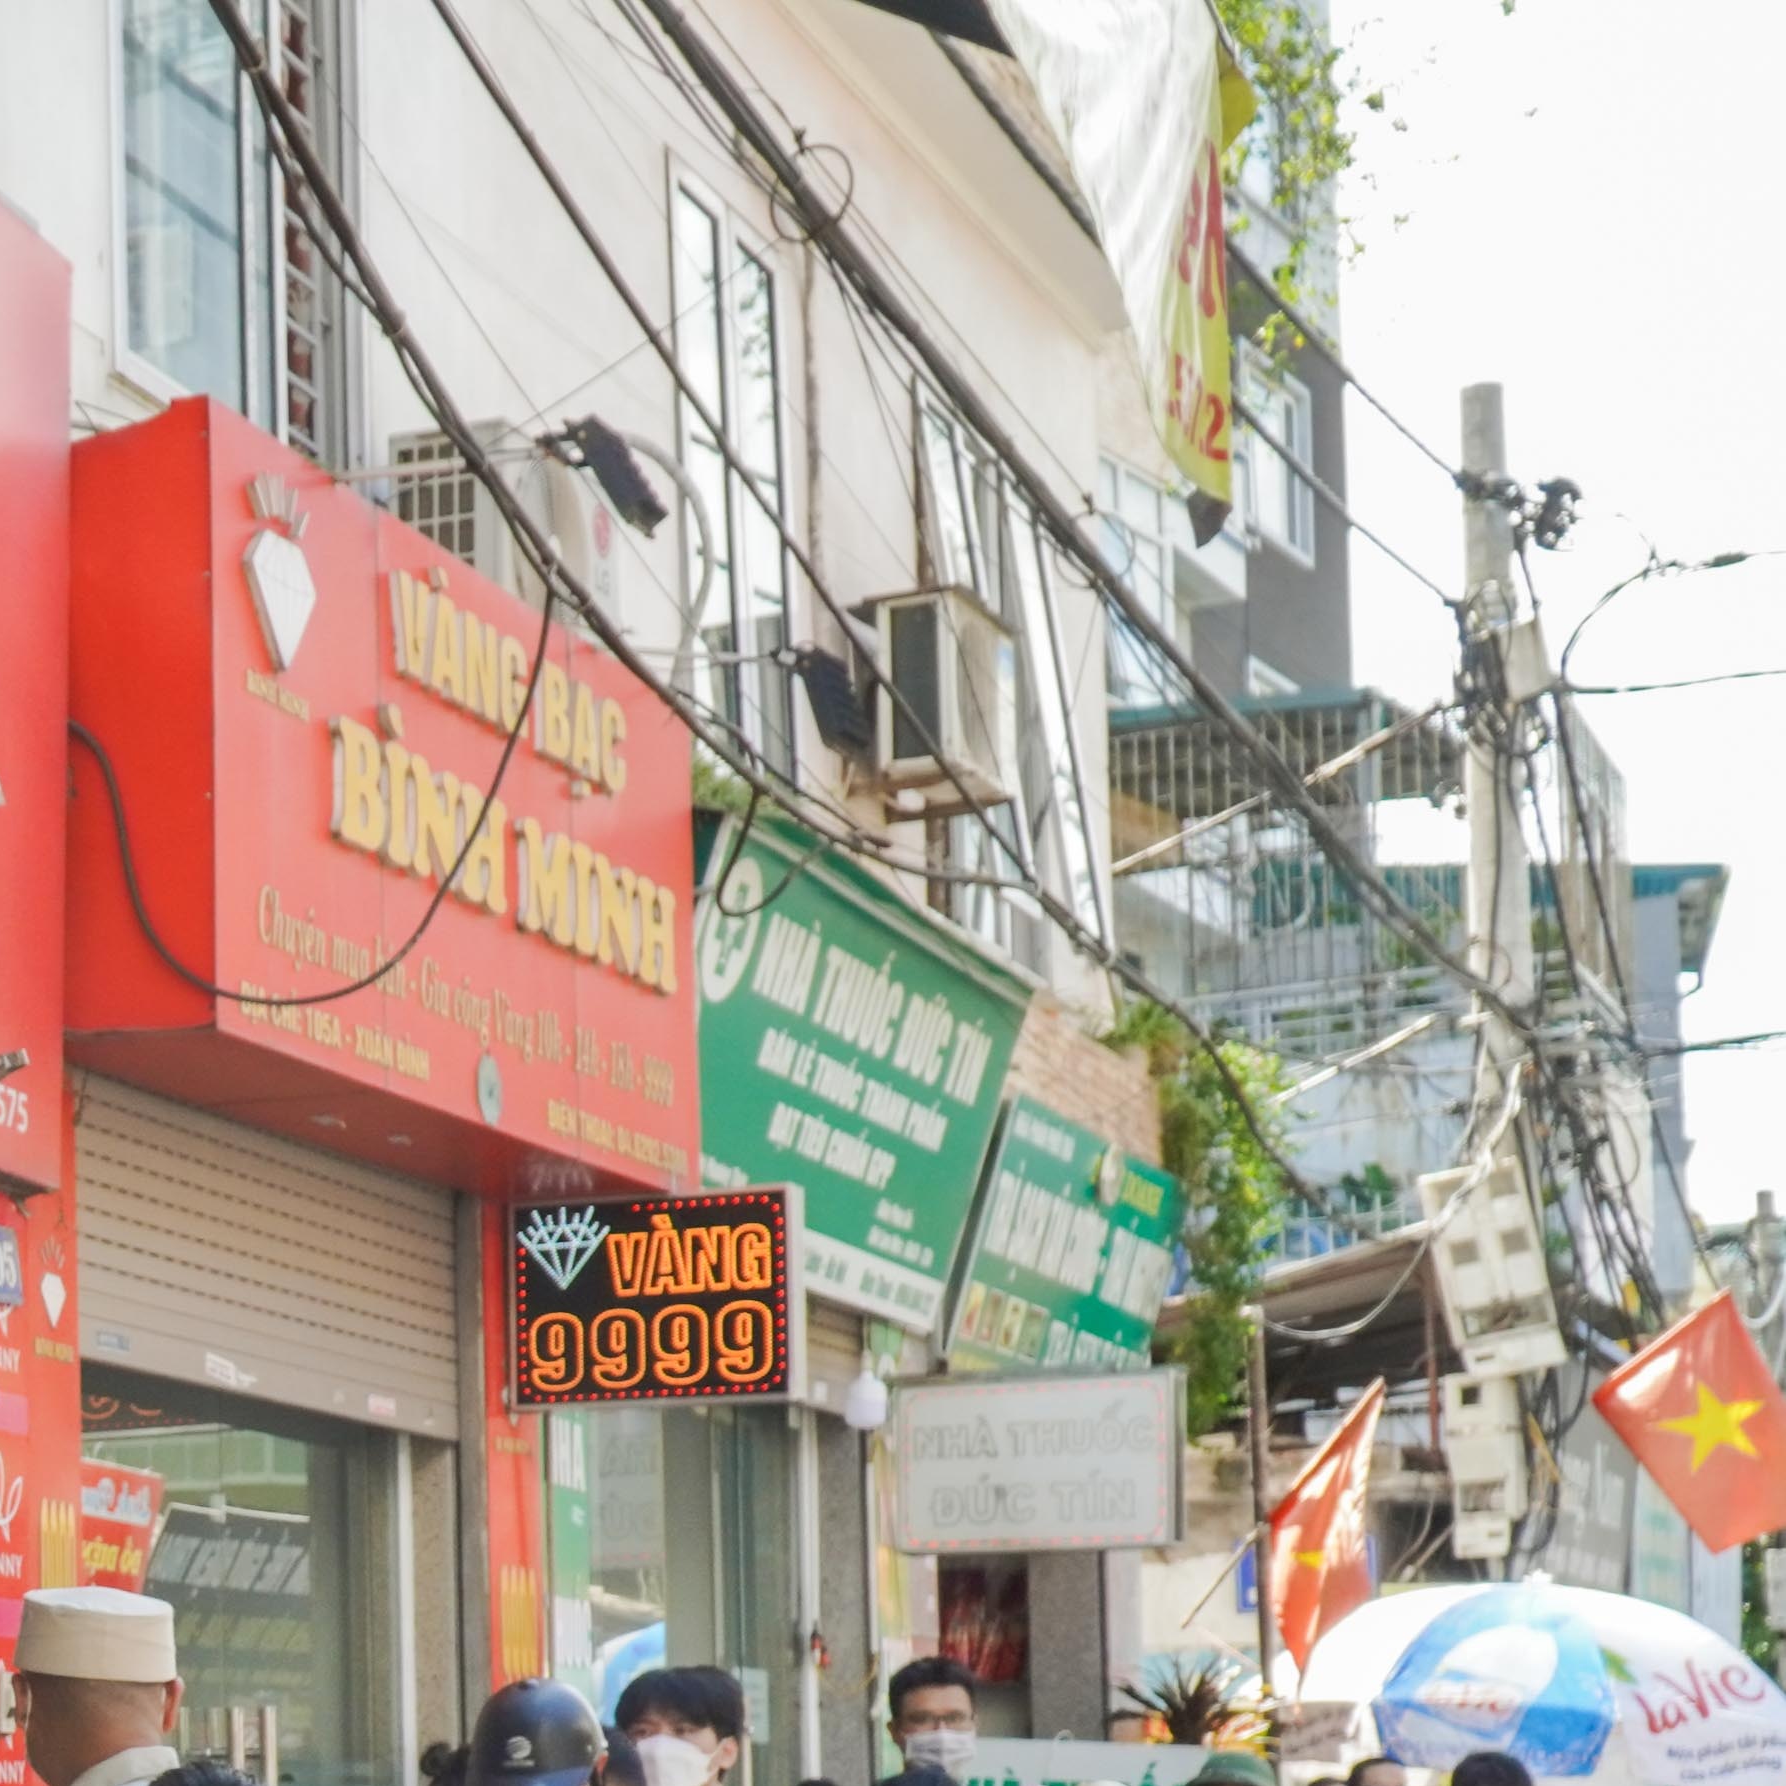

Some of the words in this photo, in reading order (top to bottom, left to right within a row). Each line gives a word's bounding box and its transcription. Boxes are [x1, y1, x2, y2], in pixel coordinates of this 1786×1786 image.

[388, 566, 529, 742] VÀNG
[534, 658, 626, 799] BẠC
[330, 703, 508, 917] BÌNH
[515, 817, 677, 997] MINH
[752, 911, 822, 1016] NHÀ
[811, 944, 906, 1060] THUỐC
[606, 1212, 773, 1299] VÀNG
[528, 1299, 774, 1393] 9999
[912, 1413, 1000, 1461] NHÀ
[1007, 1399, 1153, 1457] THUỐC
